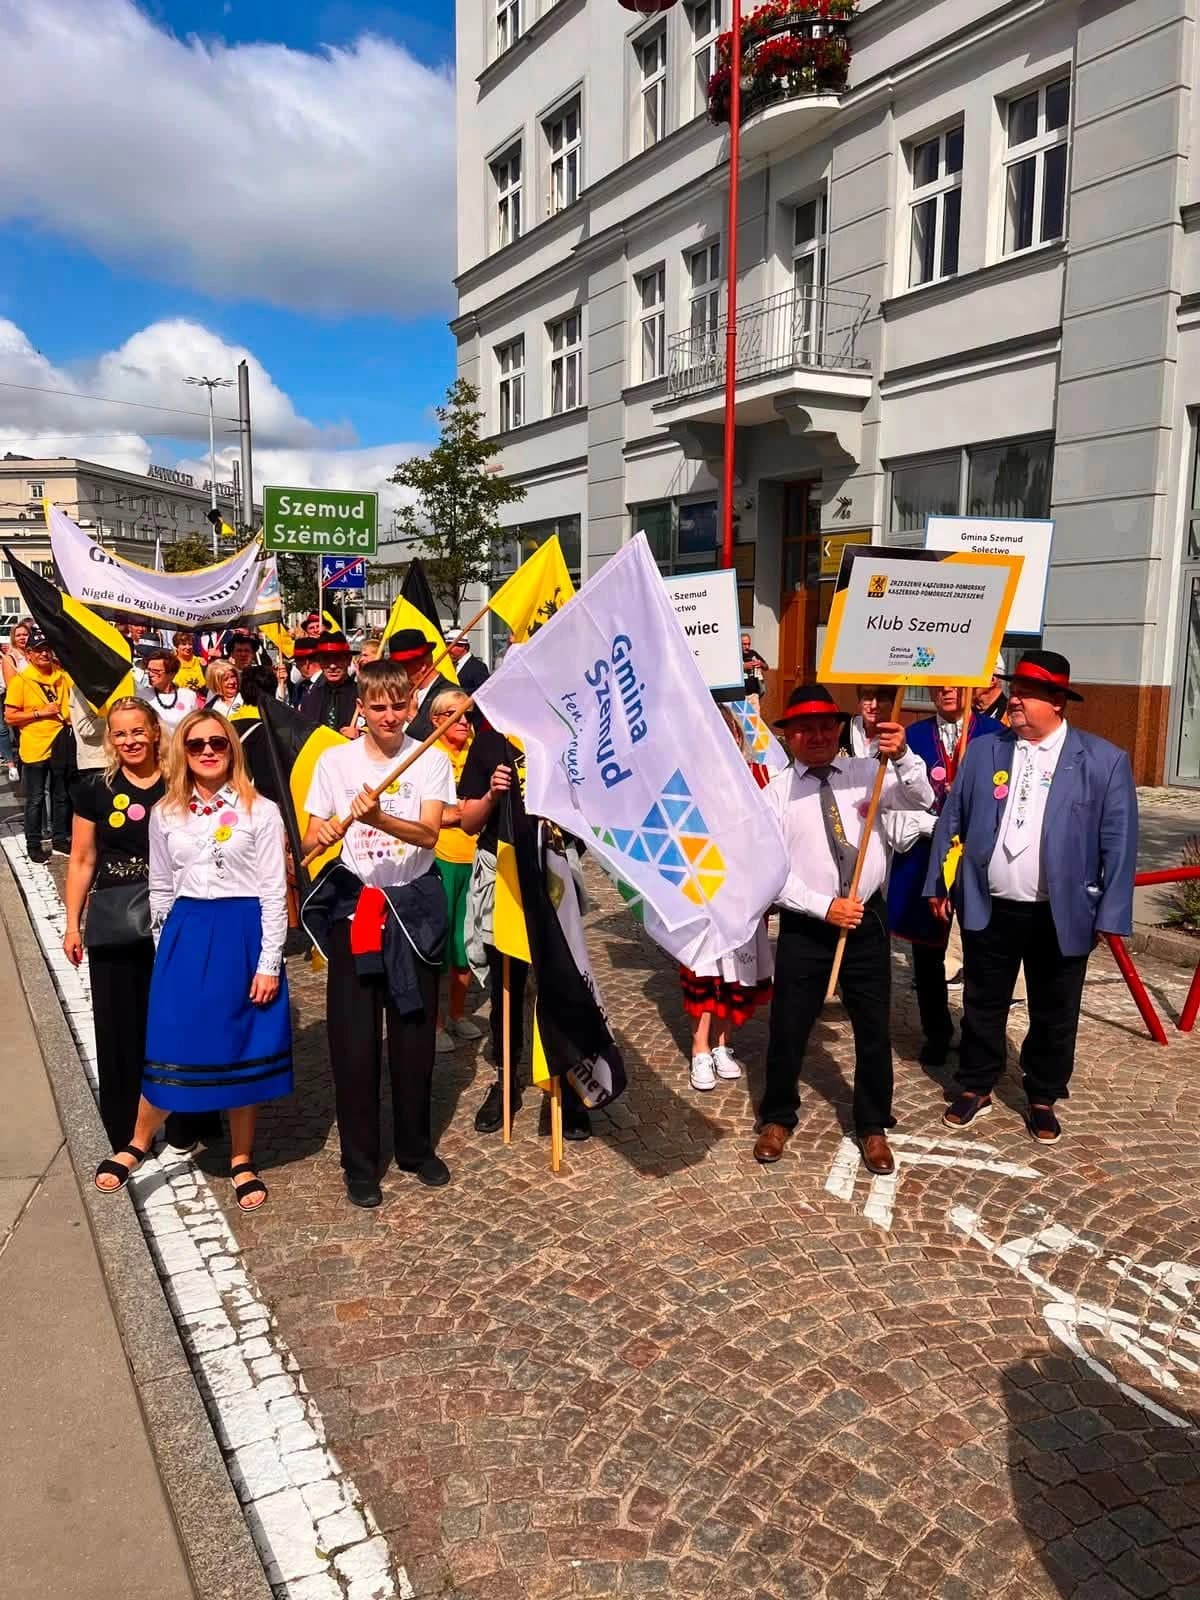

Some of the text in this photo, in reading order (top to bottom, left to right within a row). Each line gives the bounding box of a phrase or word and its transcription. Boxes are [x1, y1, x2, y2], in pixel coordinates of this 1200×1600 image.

[278, 496, 365, 519] Szemud
[272, 523, 370, 547] Szëmôłd
[960, 532, 1024, 543] Gmina Szemud
[81, 587, 114, 600] Nigdë
[117, 593, 132, 604] do
[168, 607, 185, 618] nie
[674, 589, 708, 601] Szemud
[684, 620, 719, 636] wiec
[866, 615, 972, 634] Klub Szemud
[612, 634, 648, 744] Gmina
[561, 692, 583, 723] ten
[584, 659, 633, 789] Szemud
